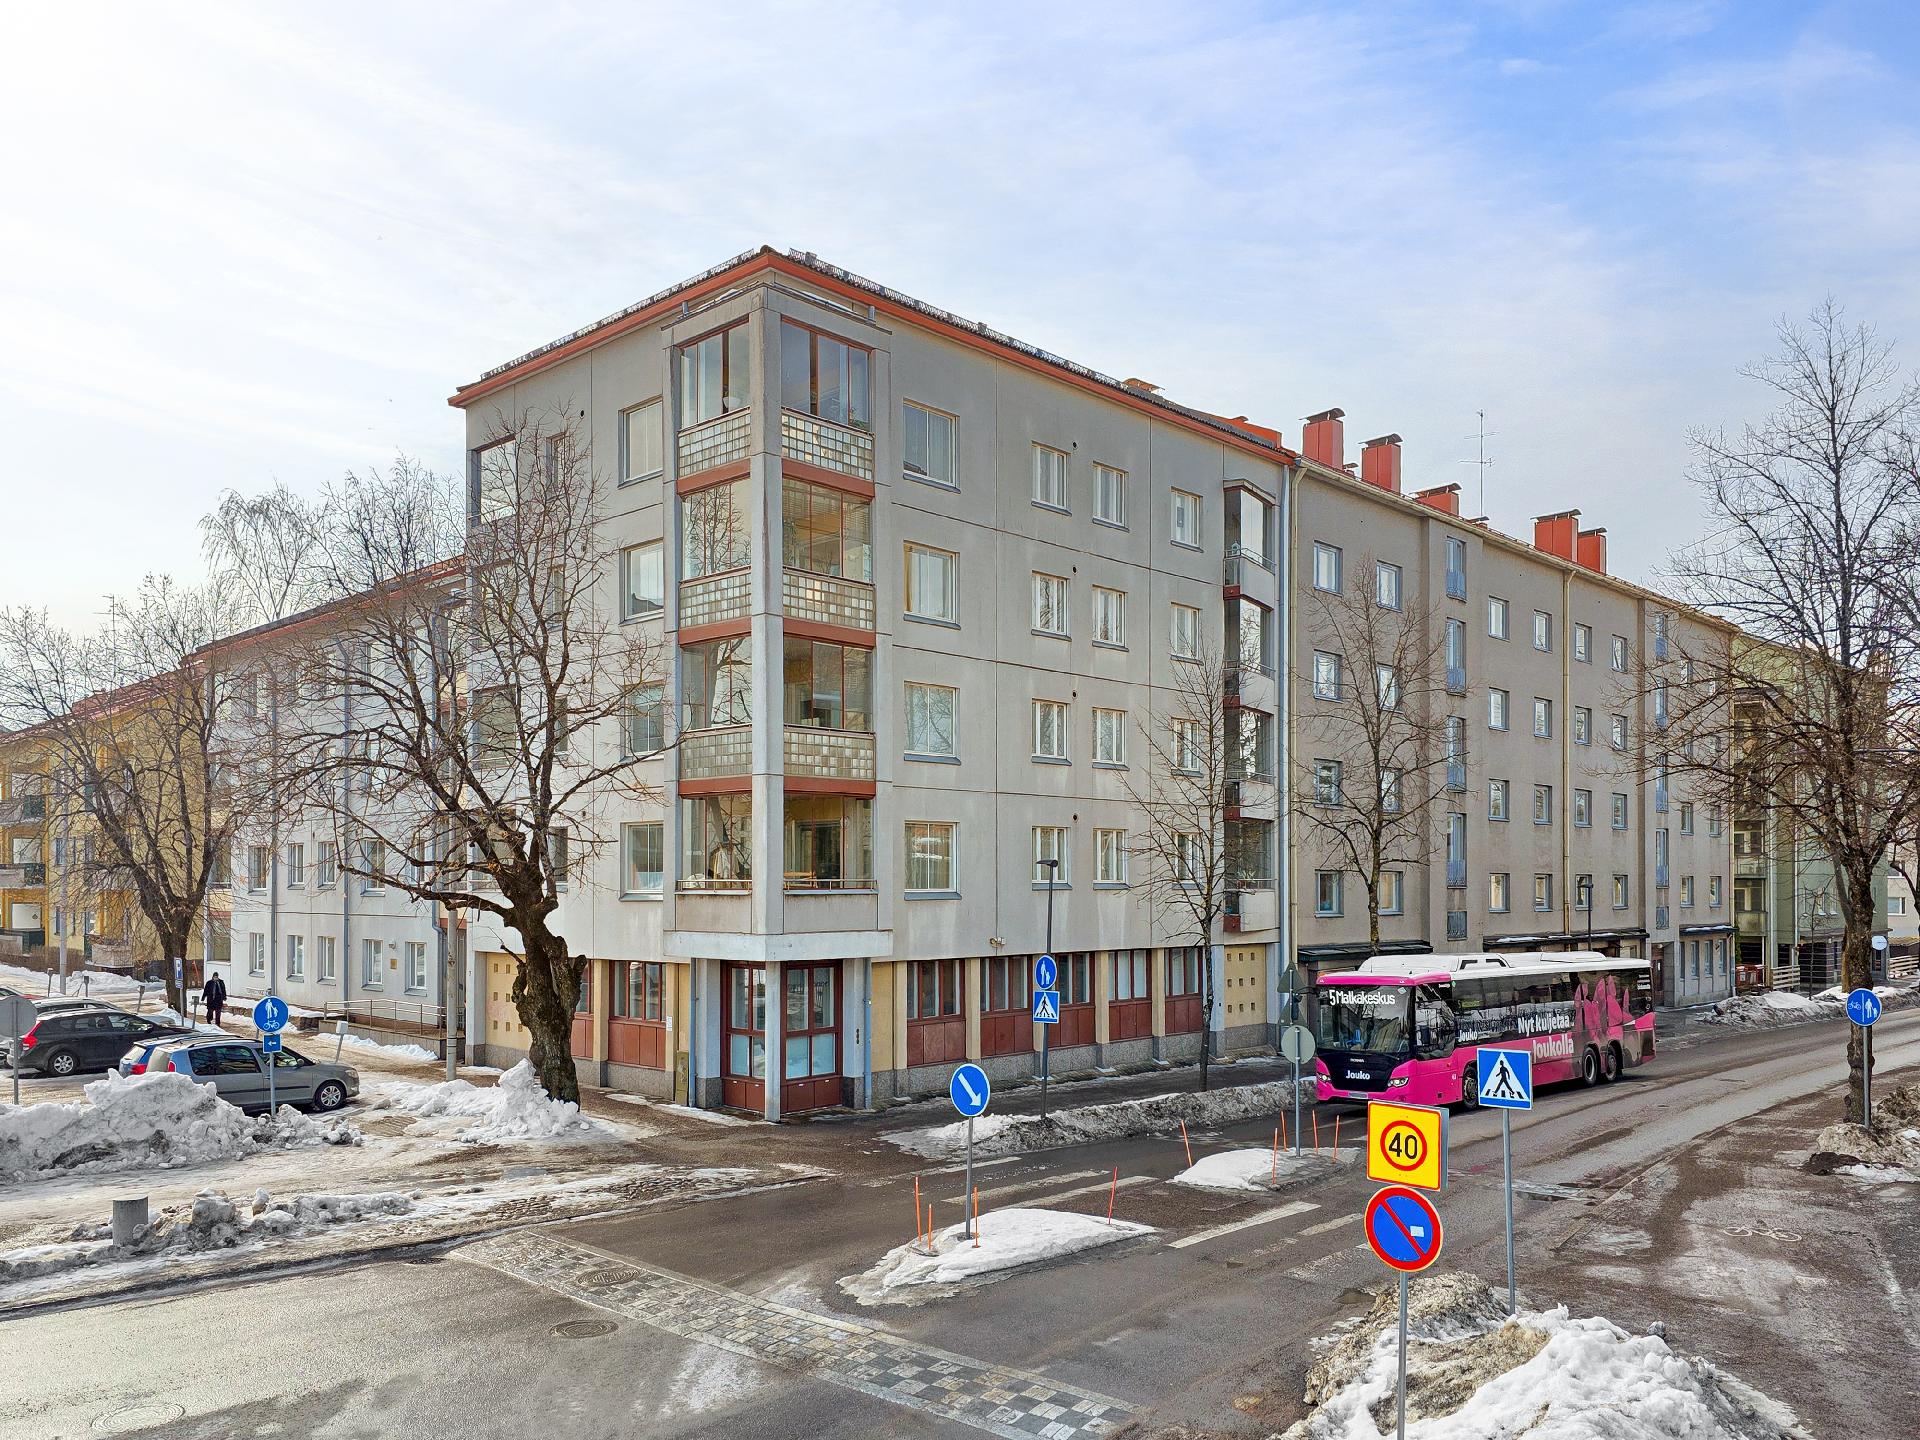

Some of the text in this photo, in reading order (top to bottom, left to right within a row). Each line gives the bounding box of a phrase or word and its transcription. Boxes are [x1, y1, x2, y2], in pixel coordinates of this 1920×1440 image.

[1329, 990, 1336, 1005] 5
[1458, 1028, 1478, 1042] Jouko
[1518, 1016, 1535, 1037] Nyt
[1533, 1033, 1575, 1063] Joukolla
[1345, 1070, 1370, 1080] Jouko
[1388, 1132, 1418, 1160] 40
